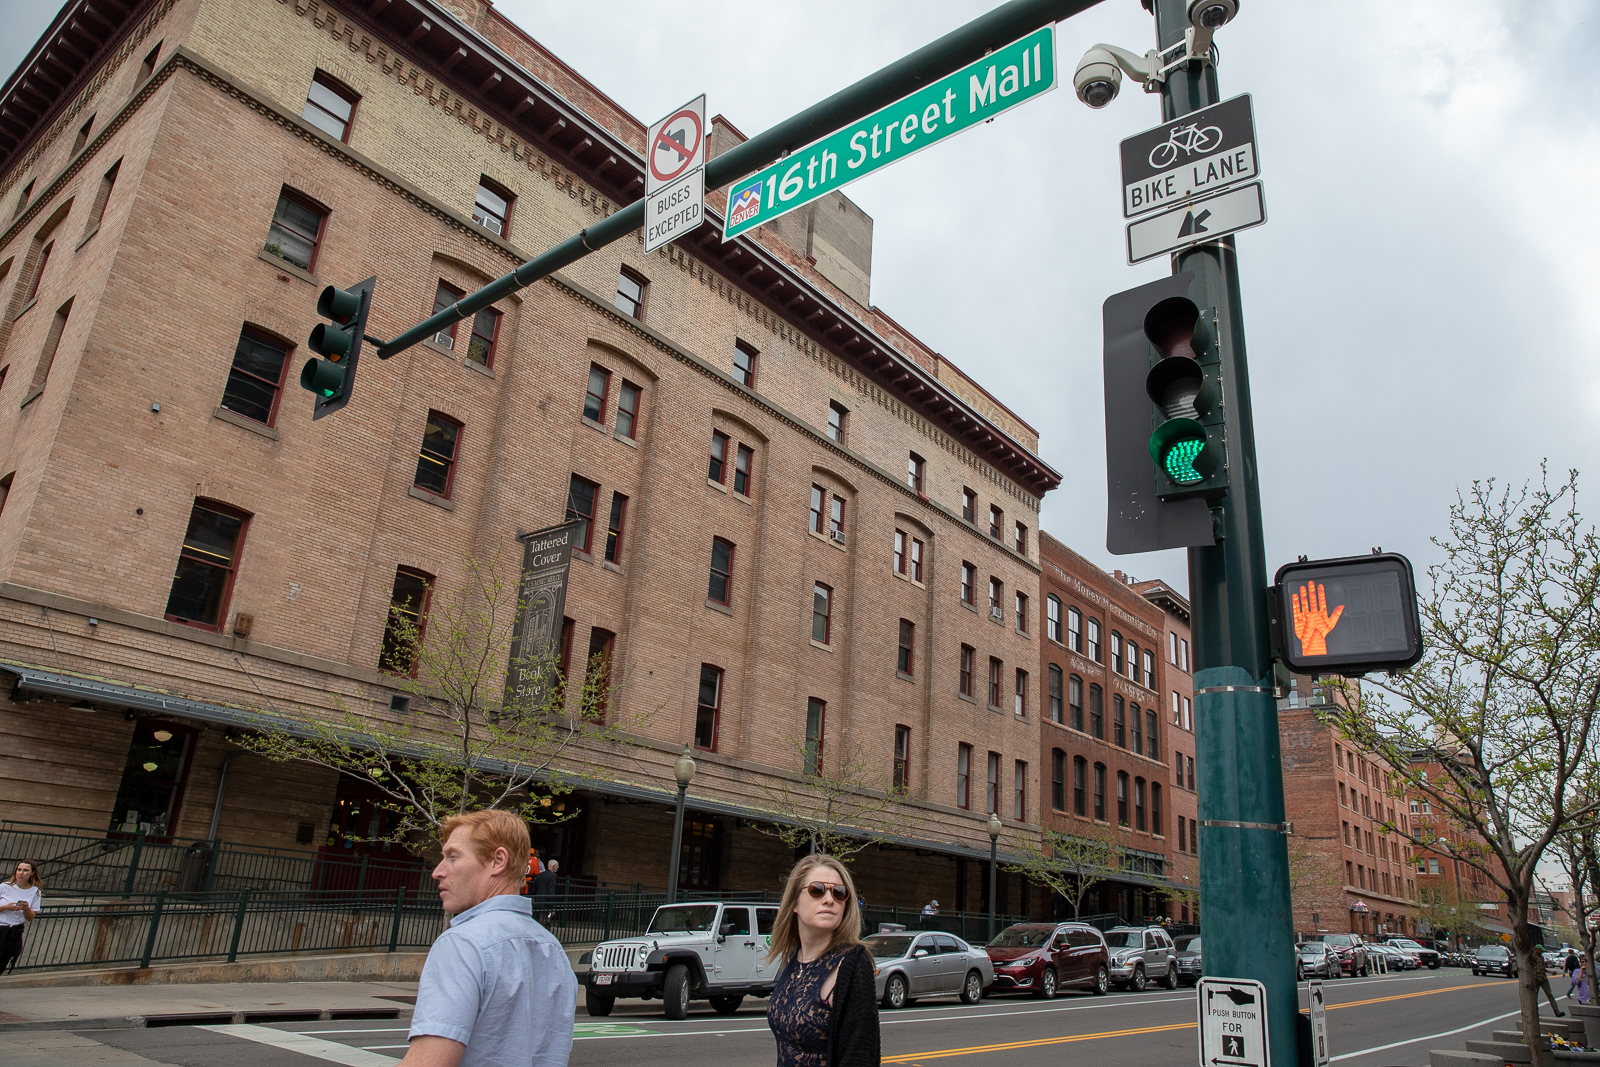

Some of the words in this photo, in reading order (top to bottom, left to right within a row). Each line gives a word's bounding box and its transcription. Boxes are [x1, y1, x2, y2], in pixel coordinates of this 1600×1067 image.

[766, 148, 837, 209] 16th
[847, 87, 956, 169] Street
[969, 42, 1041, 114] Mall
[1131, 175, 1176, 208] BIKE
[1193, 151, 1248, 187] LANE
[657, 185, 690, 215] BUSES
[648, 203, 699, 242] EXCEPTED
[730, 204, 759, 228] DENVER
[530, 532, 569, 553] Tattered
[532, 552, 562, 567] Cover
[1212, 1008, 1230, 1018] PUSH
[1232, 1010, 1257, 1020] BUTTON
[1222, 1022, 1242, 1033] FOR
